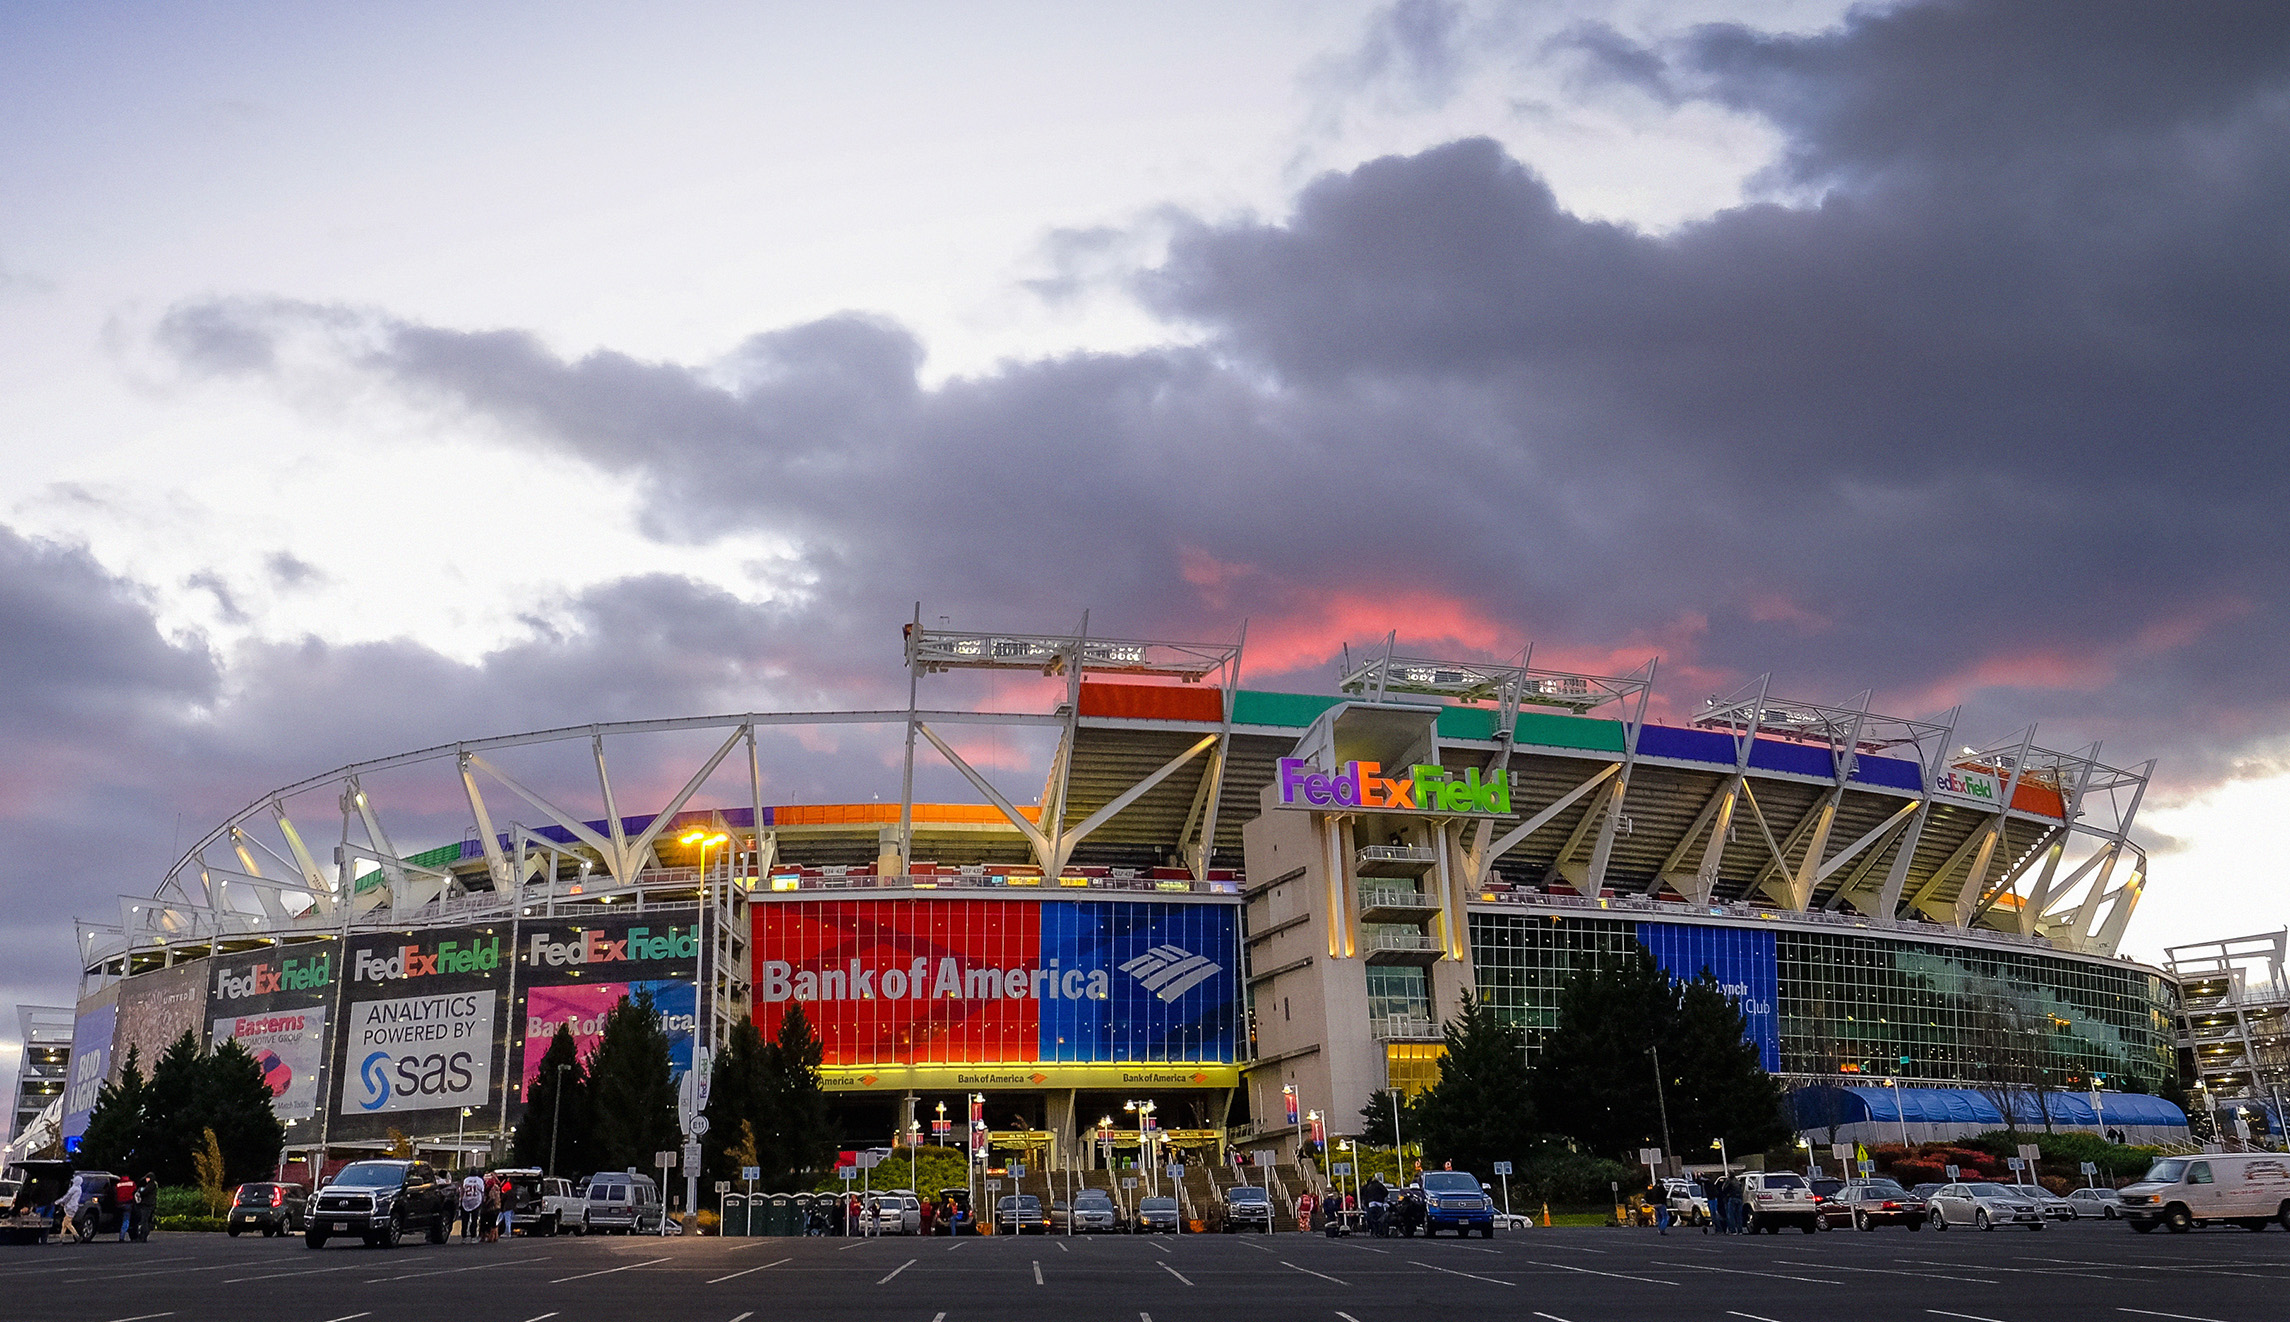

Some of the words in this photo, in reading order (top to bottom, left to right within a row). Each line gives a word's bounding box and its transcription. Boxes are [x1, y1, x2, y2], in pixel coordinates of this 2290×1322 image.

[1277, 757, 1512, 814] FedExField
[1936, 772, 1993, 799] edExField
[354, 936, 499, 981] FedExField
[530, 924, 698, 966] FedExField
[217, 953, 330, 1000] FedExField
[763, 958, 874, 1002] Bank
[881, 956, 927, 1000] of
[932, 957, 1108, 1000] America
[366, 996, 477, 1025] ANALYTICS
[1745, 999, 1770, 1014] Club
[278, 1032, 304, 1043] GROUP
[364, 1024, 448, 1046] POWERED
[453, 1021, 476, 1039] BY
[77, 1048, 101, 1084] BUD
[958, 1074, 979, 1083] Bank
[980, 1074, 989, 1083] of
[990, 1074, 1024, 1083] America
[1123, 1073, 1143, 1082] Bank
[1144, 1073, 1153, 1082] of
[1153, 1073, 1186, 1082] America
[818, 1076, 854, 1086] America
[69, 1077, 102, 1115] LIGHT
